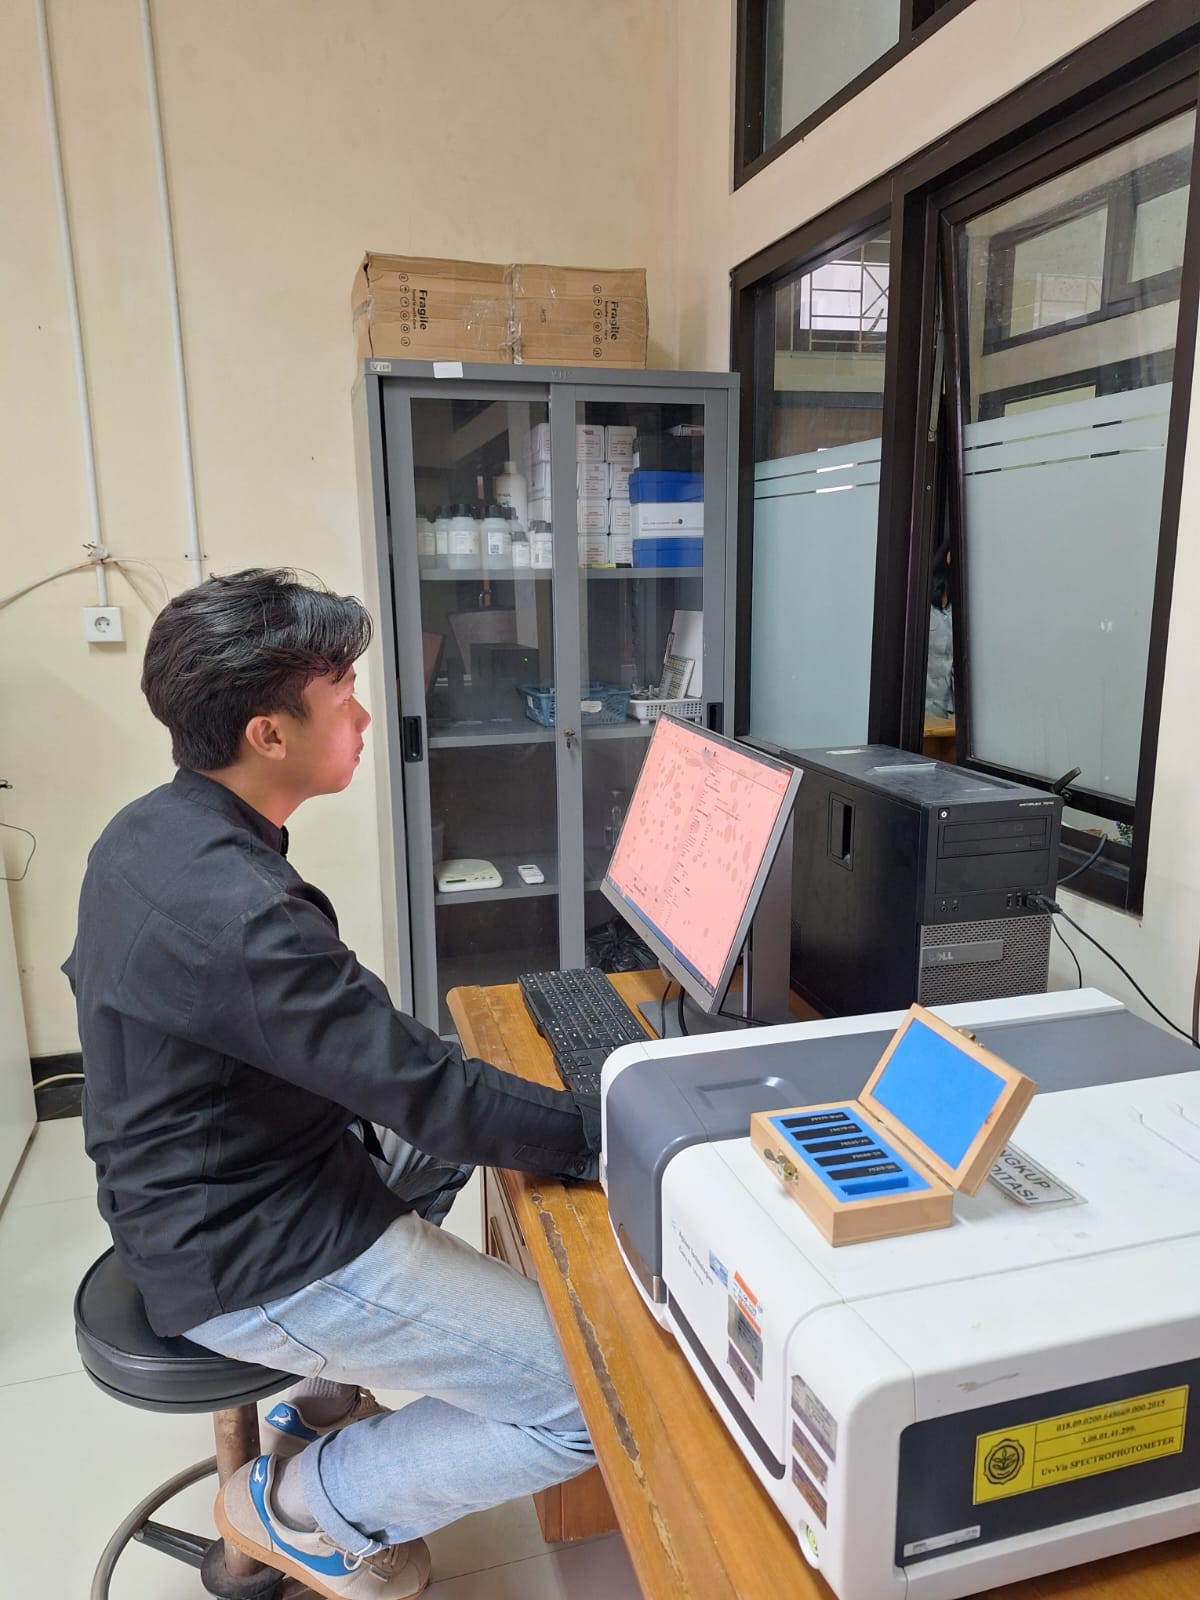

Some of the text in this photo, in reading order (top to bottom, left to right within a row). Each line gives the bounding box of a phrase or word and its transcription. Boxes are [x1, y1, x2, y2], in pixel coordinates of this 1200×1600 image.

[417, 289, 430, 331] Fragile
[609, 301, 620, 341] Fragile
[1070, 1435, 1175, 1470] SPECTROPHOTOMETER
